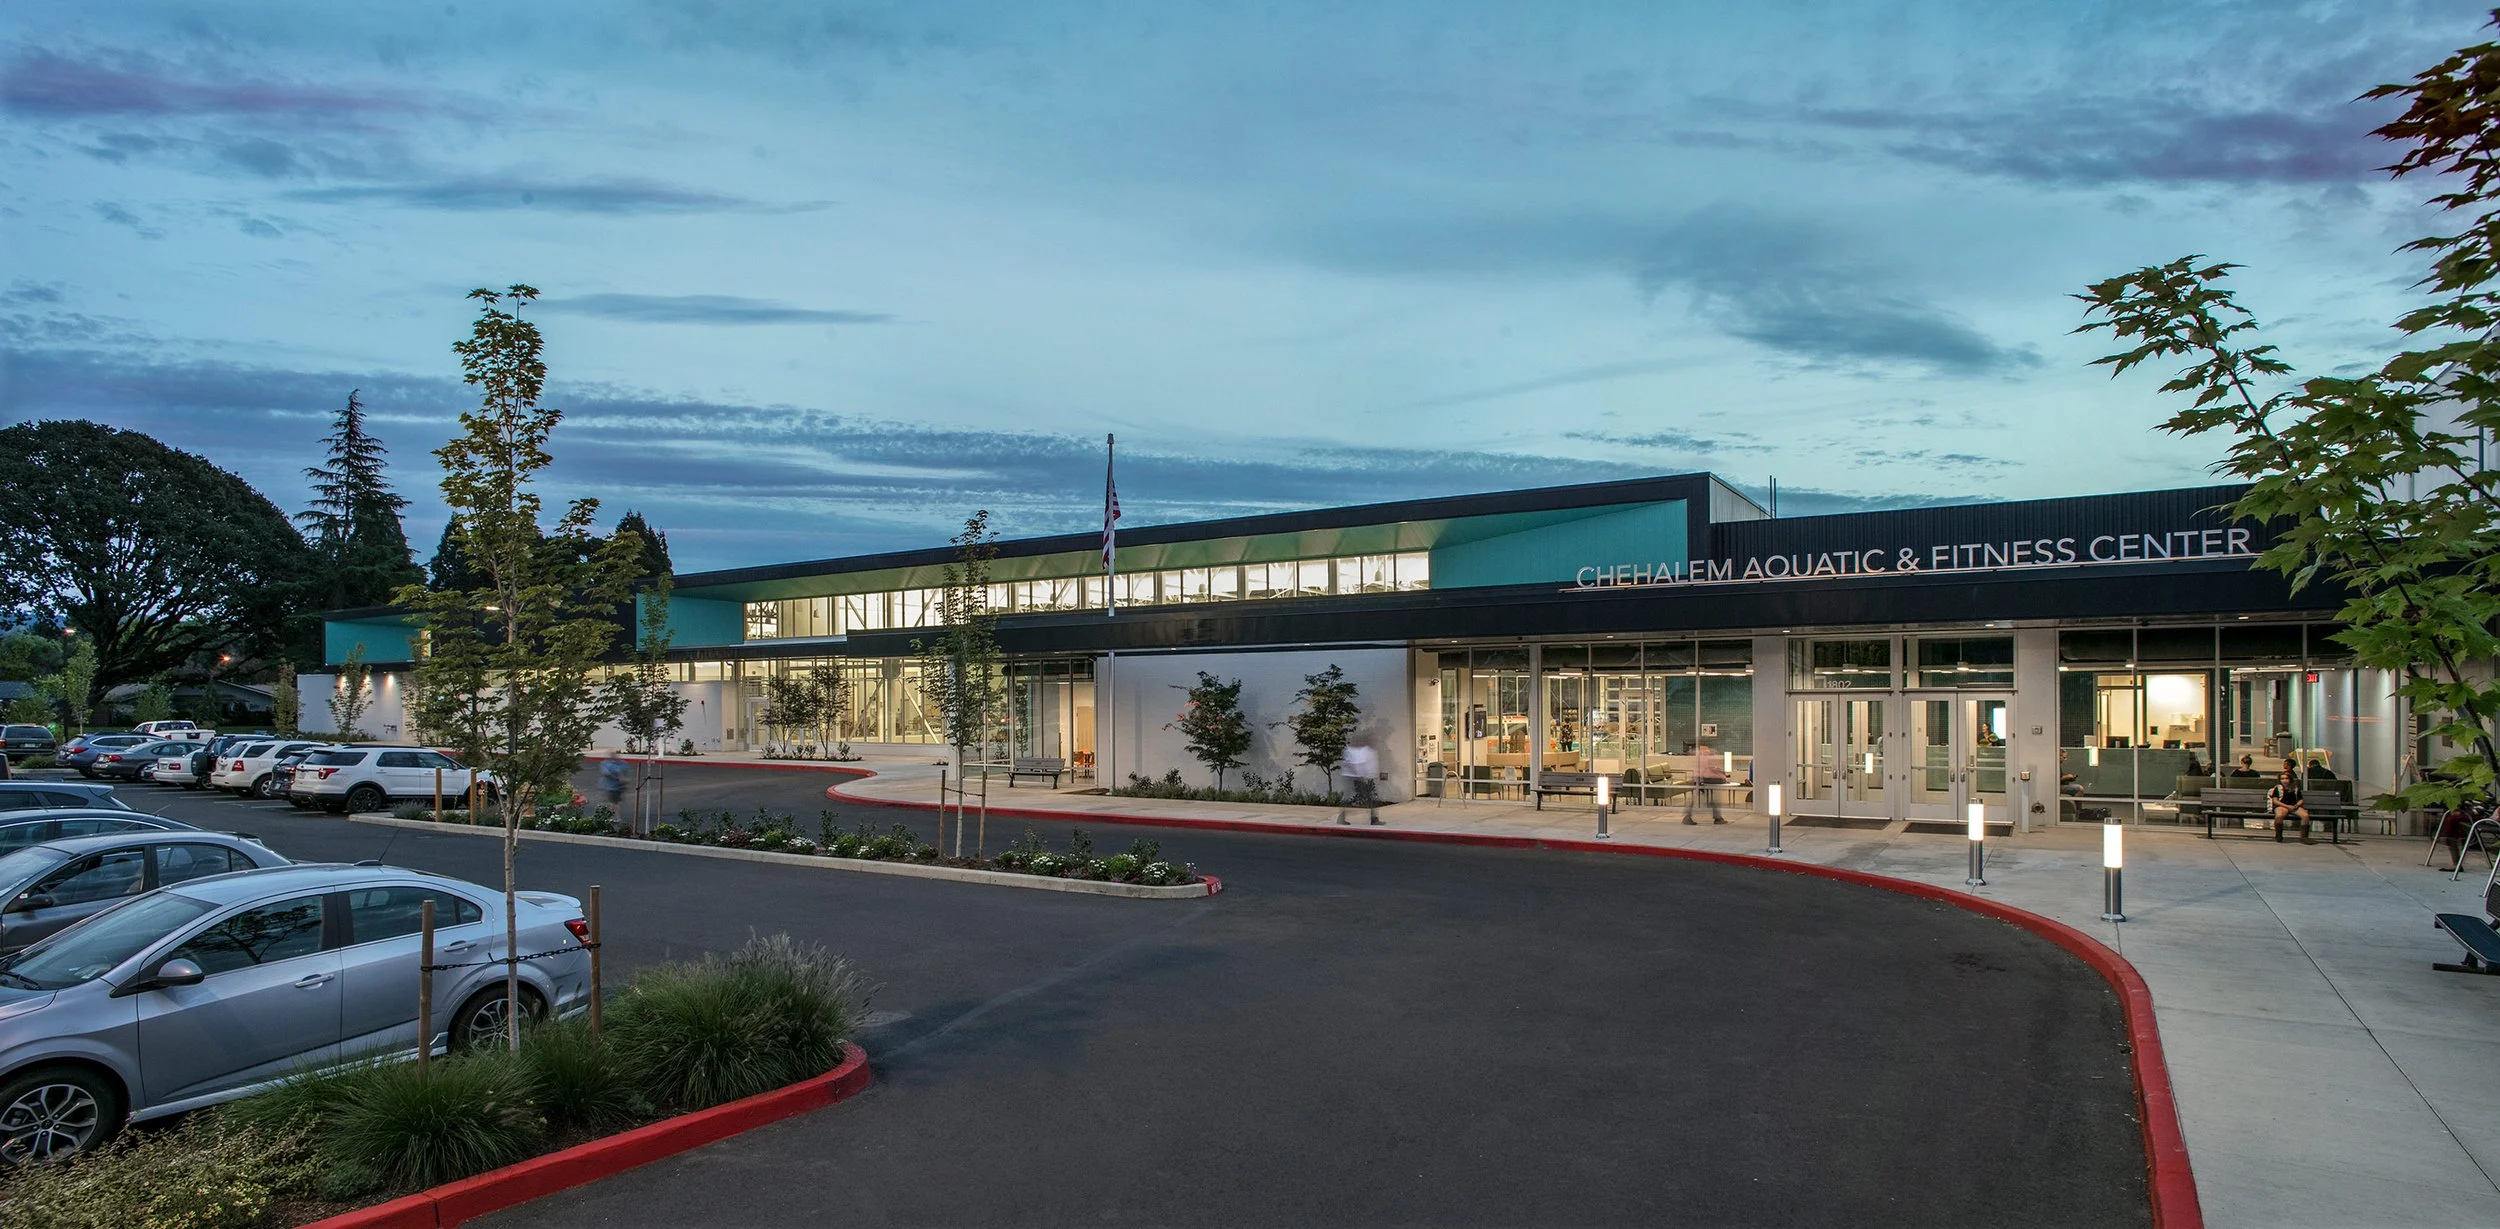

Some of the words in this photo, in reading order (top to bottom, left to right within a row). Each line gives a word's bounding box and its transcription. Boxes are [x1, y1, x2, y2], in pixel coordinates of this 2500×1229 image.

[1576, 558, 1732, 588] CHEHALEM
[1742, 549, 1886, 579] AQUATIC
[1896, 547, 1921, 572] &
[1932, 537, 2076, 570] FITNESS
[2089, 528, 2251, 561] CENTER
[1828, 680, 1852, 689] 1802
